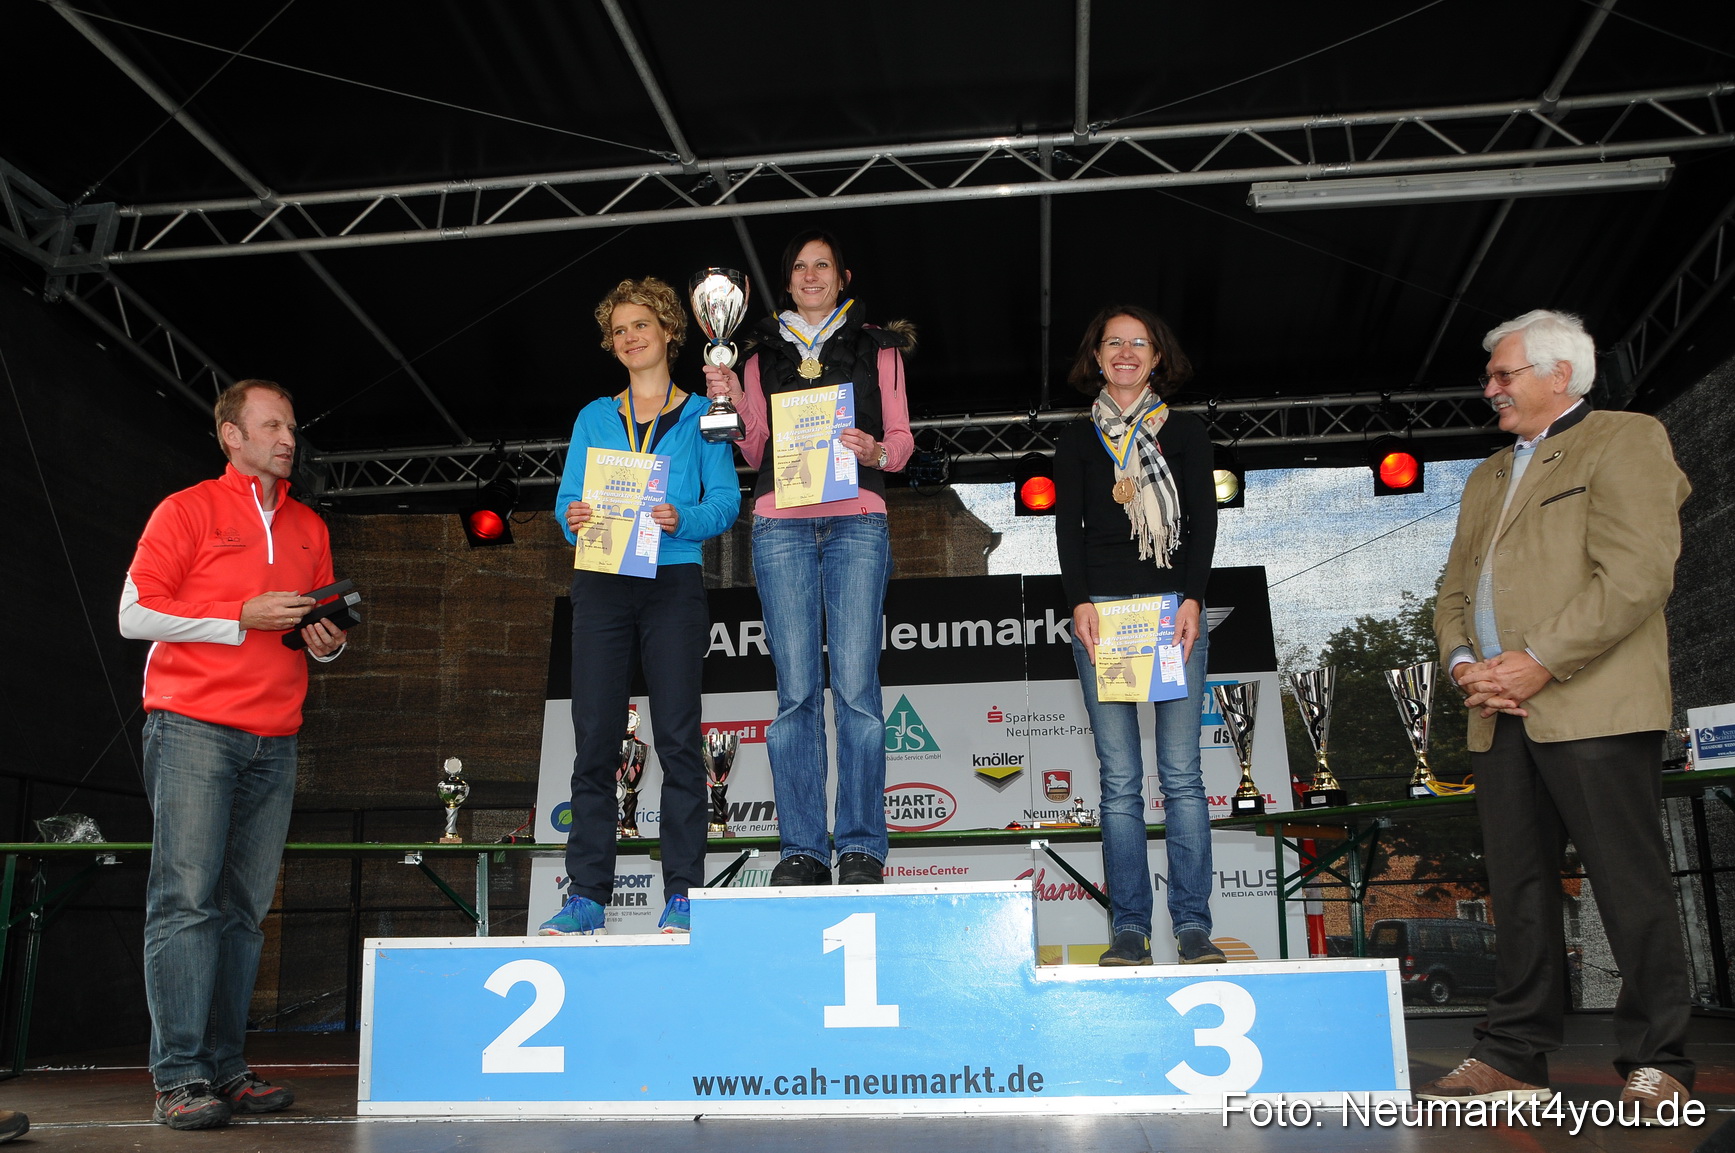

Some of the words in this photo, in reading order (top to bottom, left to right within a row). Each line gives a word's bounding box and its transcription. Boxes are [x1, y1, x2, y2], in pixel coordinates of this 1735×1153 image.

[781, 389, 847, 408] URKUNDE
[597, 454, 663, 471] URKUNDE
[1102, 600, 1171, 616] URKUNDE
[881, 608, 1072, 650] eumark
[1149, 630, 1175, 638] Stadtlau
[1005, 712, 1066, 724] Sparkasse
[1006, 725, 1094, 737] Neumarkt-Pars
[972, 752, 1025, 767] knöller
[1206, 795, 1228, 806] AX
[749, 824, 779, 832] neuma
[881, 867, 894, 877] UI
[897, 865, 969, 877] ReiseCenter
[822, 911, 900, 1029] 1
[481, 958, 566, 1075] 2
[1165, 981, 1263, 1097] 3
[693, 1064, 1044, 1097] www.cah-neumarkt.de
